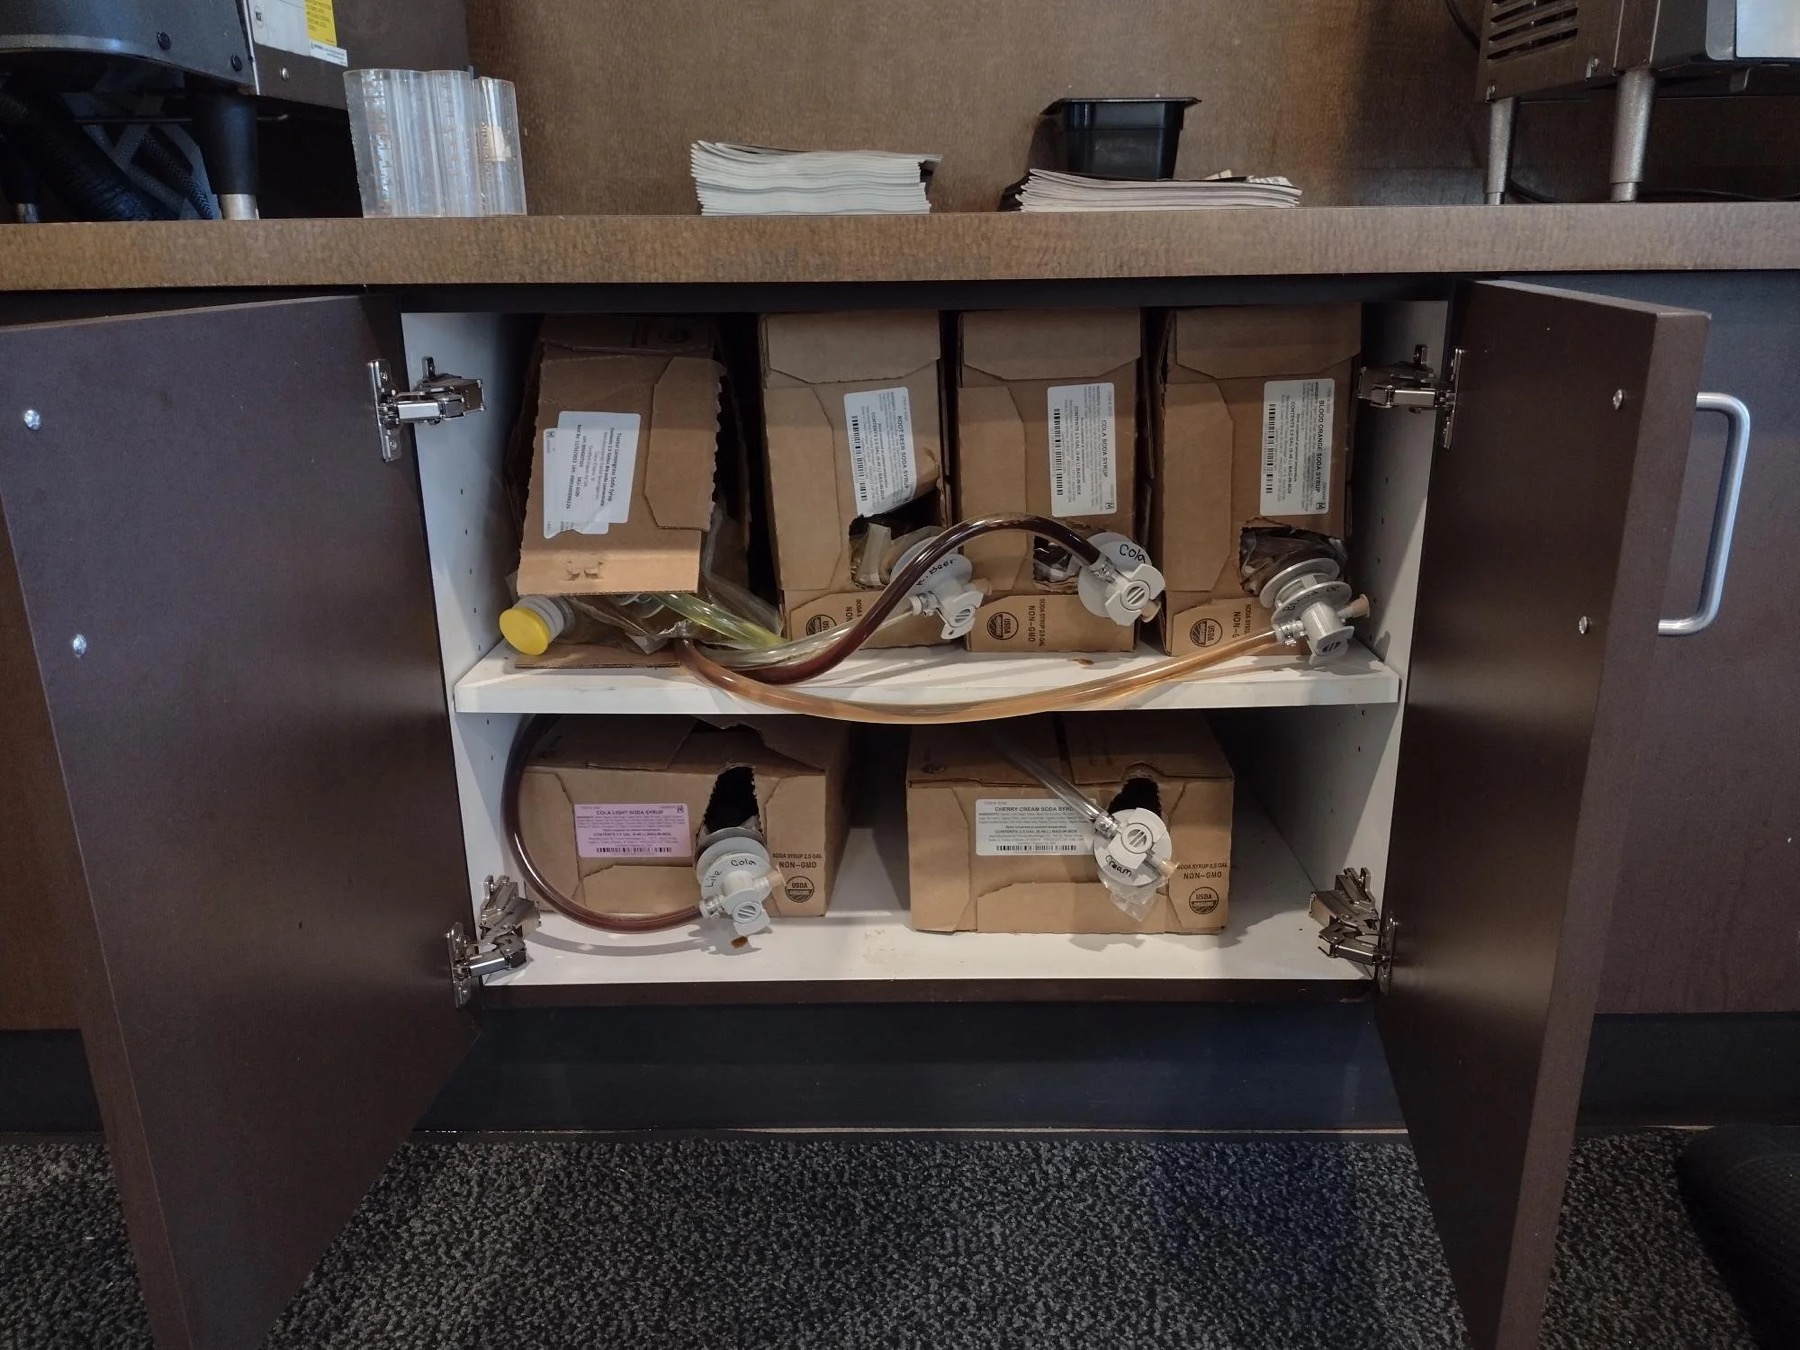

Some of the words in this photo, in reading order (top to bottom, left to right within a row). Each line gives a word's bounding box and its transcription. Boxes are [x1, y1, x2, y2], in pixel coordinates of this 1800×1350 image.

[1120, 543, 1146, 564] Cola
[1028, 605, 1036, 642] NON-GMO
[1207, 625, 1215, 641] USDA
[731, 857, 756, 867] Cola
[1105, 855, 1133, 877] Cream
[1183, 871, 1222, 879] NON-GMO
